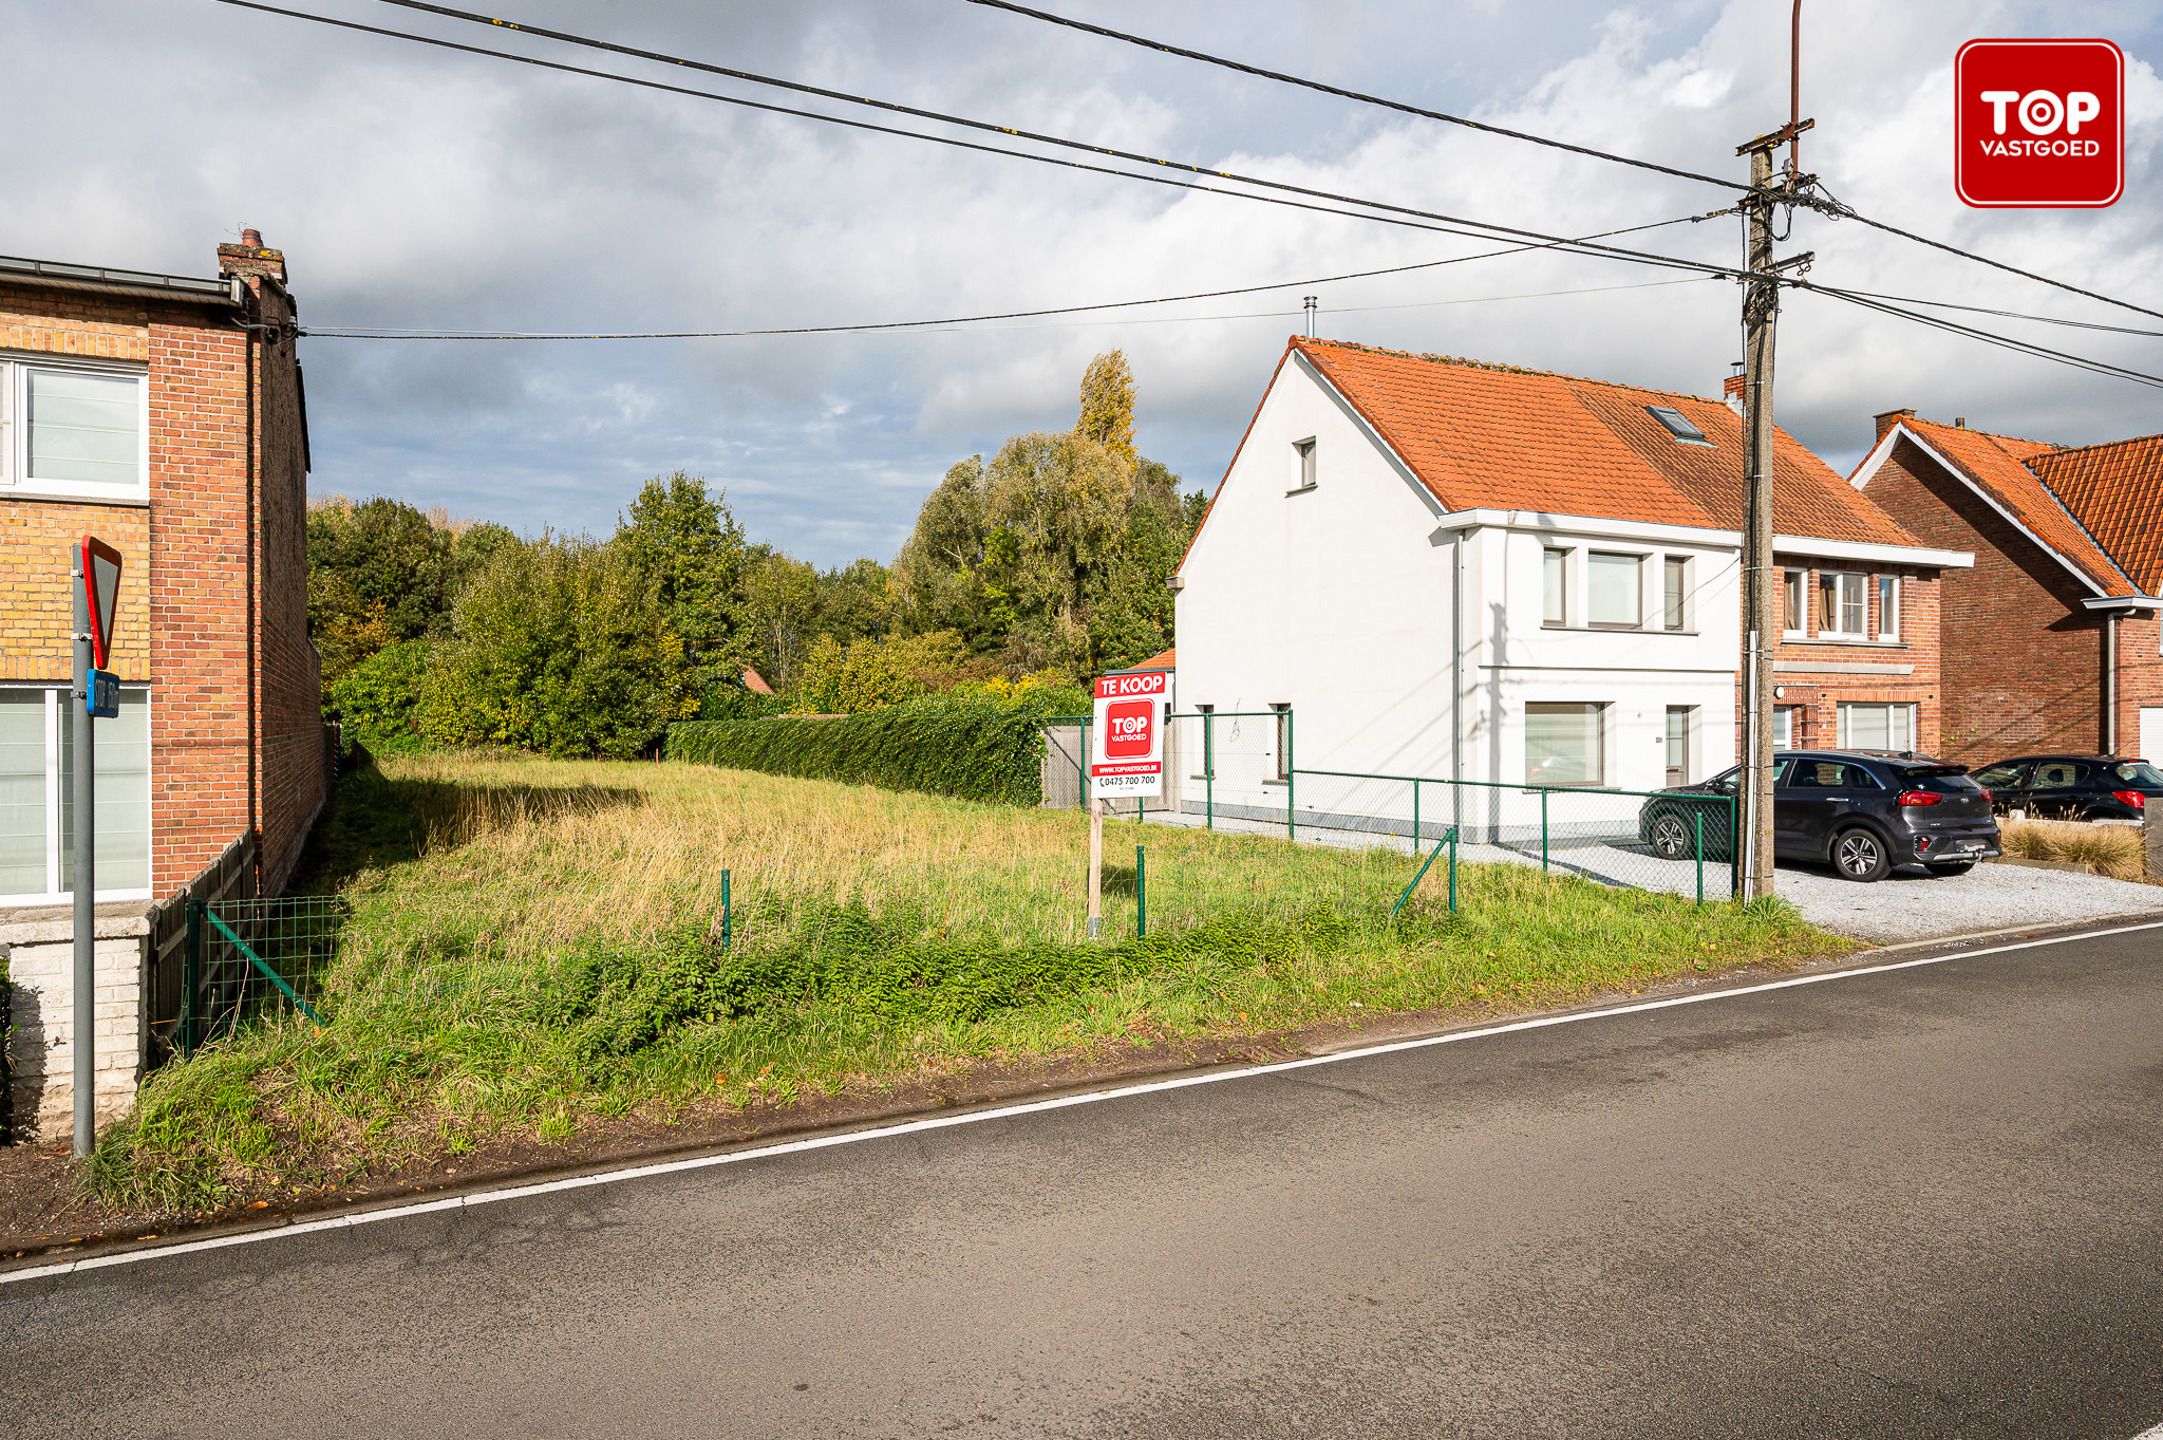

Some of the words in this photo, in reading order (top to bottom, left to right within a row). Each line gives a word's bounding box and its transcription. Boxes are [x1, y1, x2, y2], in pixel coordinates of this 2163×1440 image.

[1101, 679, 1117, 695] TE
[1120, 675, 1163, 694] KOOP
[95, 679, 106, 708] STOP
[1112, 716, 1148, 734] TOP
[1111, 733, 1147, 742] VASTGOED
[1099, 765, 1158, 774] WWW.TOPVASTGOED.BE
[1105, 776, 1123, 786] 0475
[1125, 776, 1139, 785] 700
[1141, 775, 1155, 784] 700
